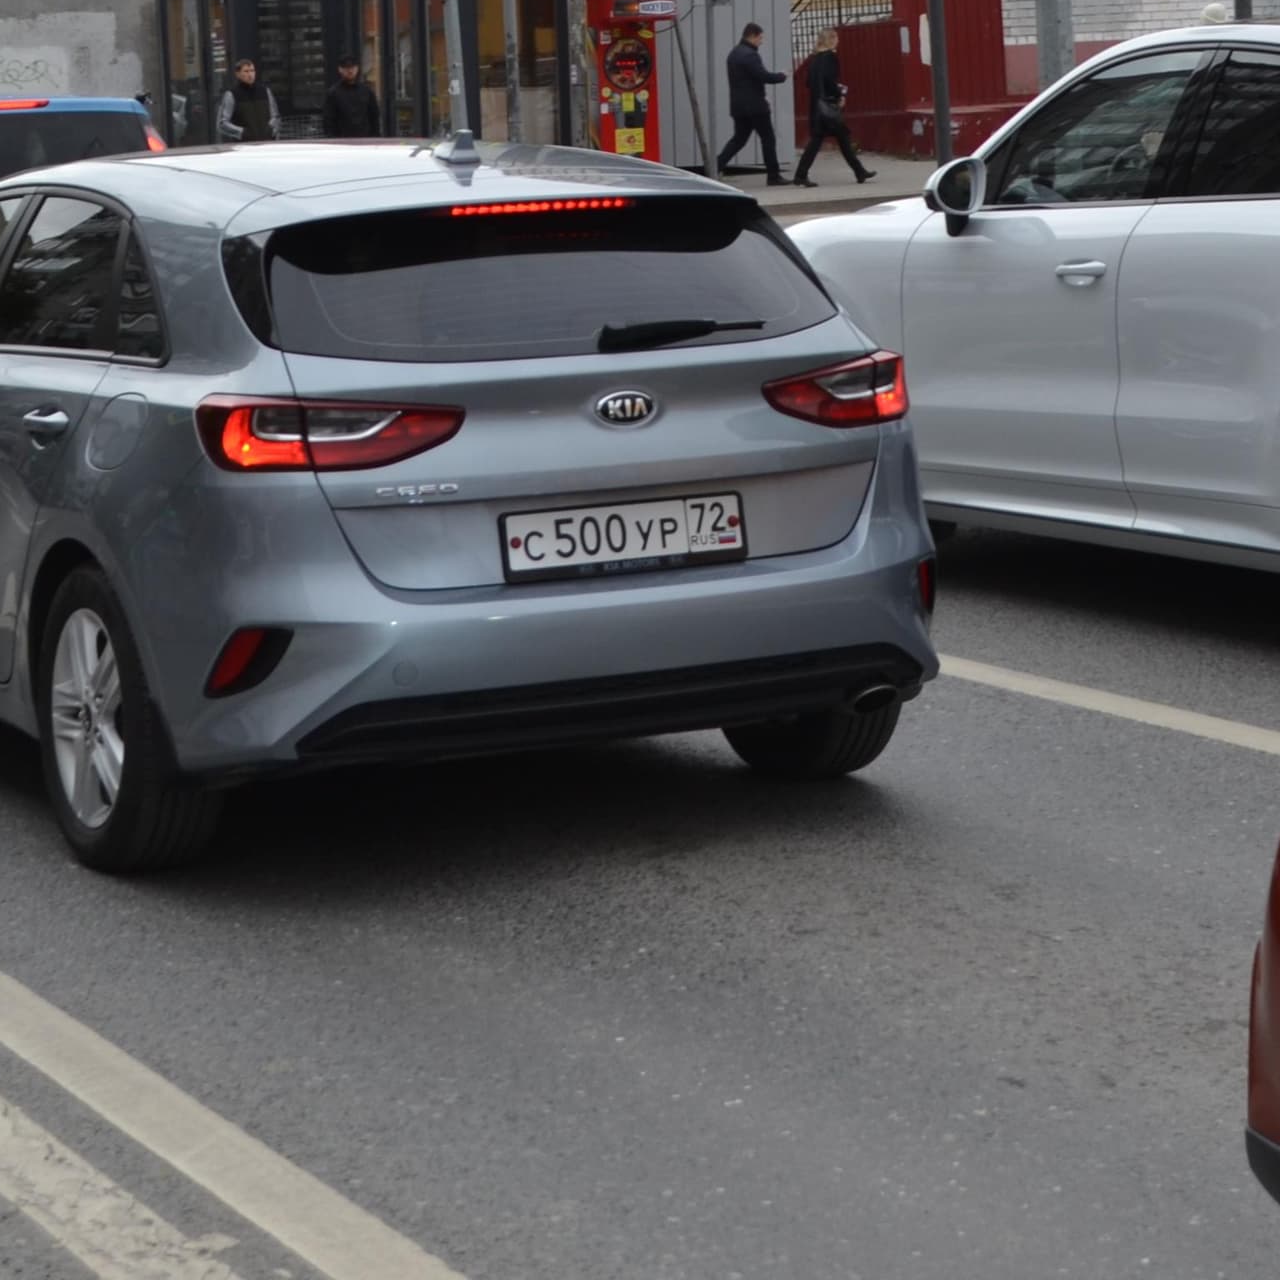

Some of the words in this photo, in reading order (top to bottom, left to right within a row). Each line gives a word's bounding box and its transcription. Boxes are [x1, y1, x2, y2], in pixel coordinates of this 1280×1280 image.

[607, 397, 649, 419] KIA
[689, 502, 727, 533] 72
[690, 533, 718, 546] RUS
